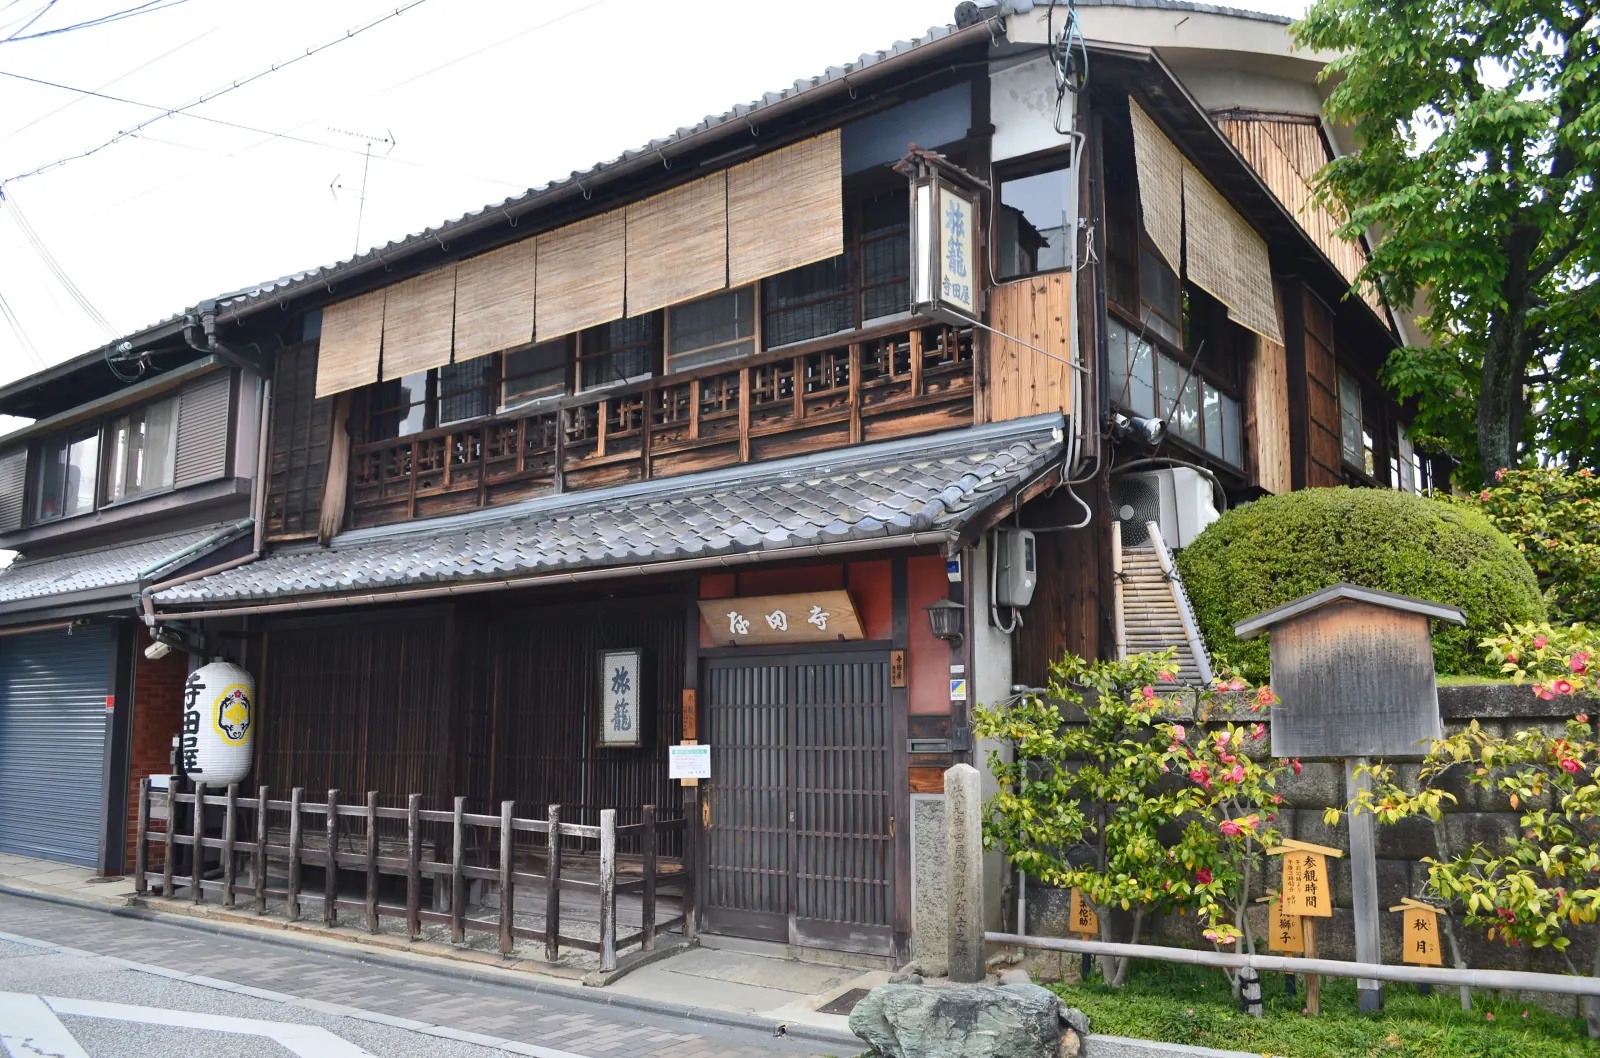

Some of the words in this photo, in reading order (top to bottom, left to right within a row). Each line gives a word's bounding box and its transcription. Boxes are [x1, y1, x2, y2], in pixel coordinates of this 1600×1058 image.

[945, 199, 967, 278] 旅籠
[942, 274, 970, 305] 寺田屋
[183, 672, 207, 774] 寺田屋
[611, 665, 632, 732] 旅籠
[1303, 855, 1318, 909] 参観時間
[1413, 918, 1428, 955] 秋月
